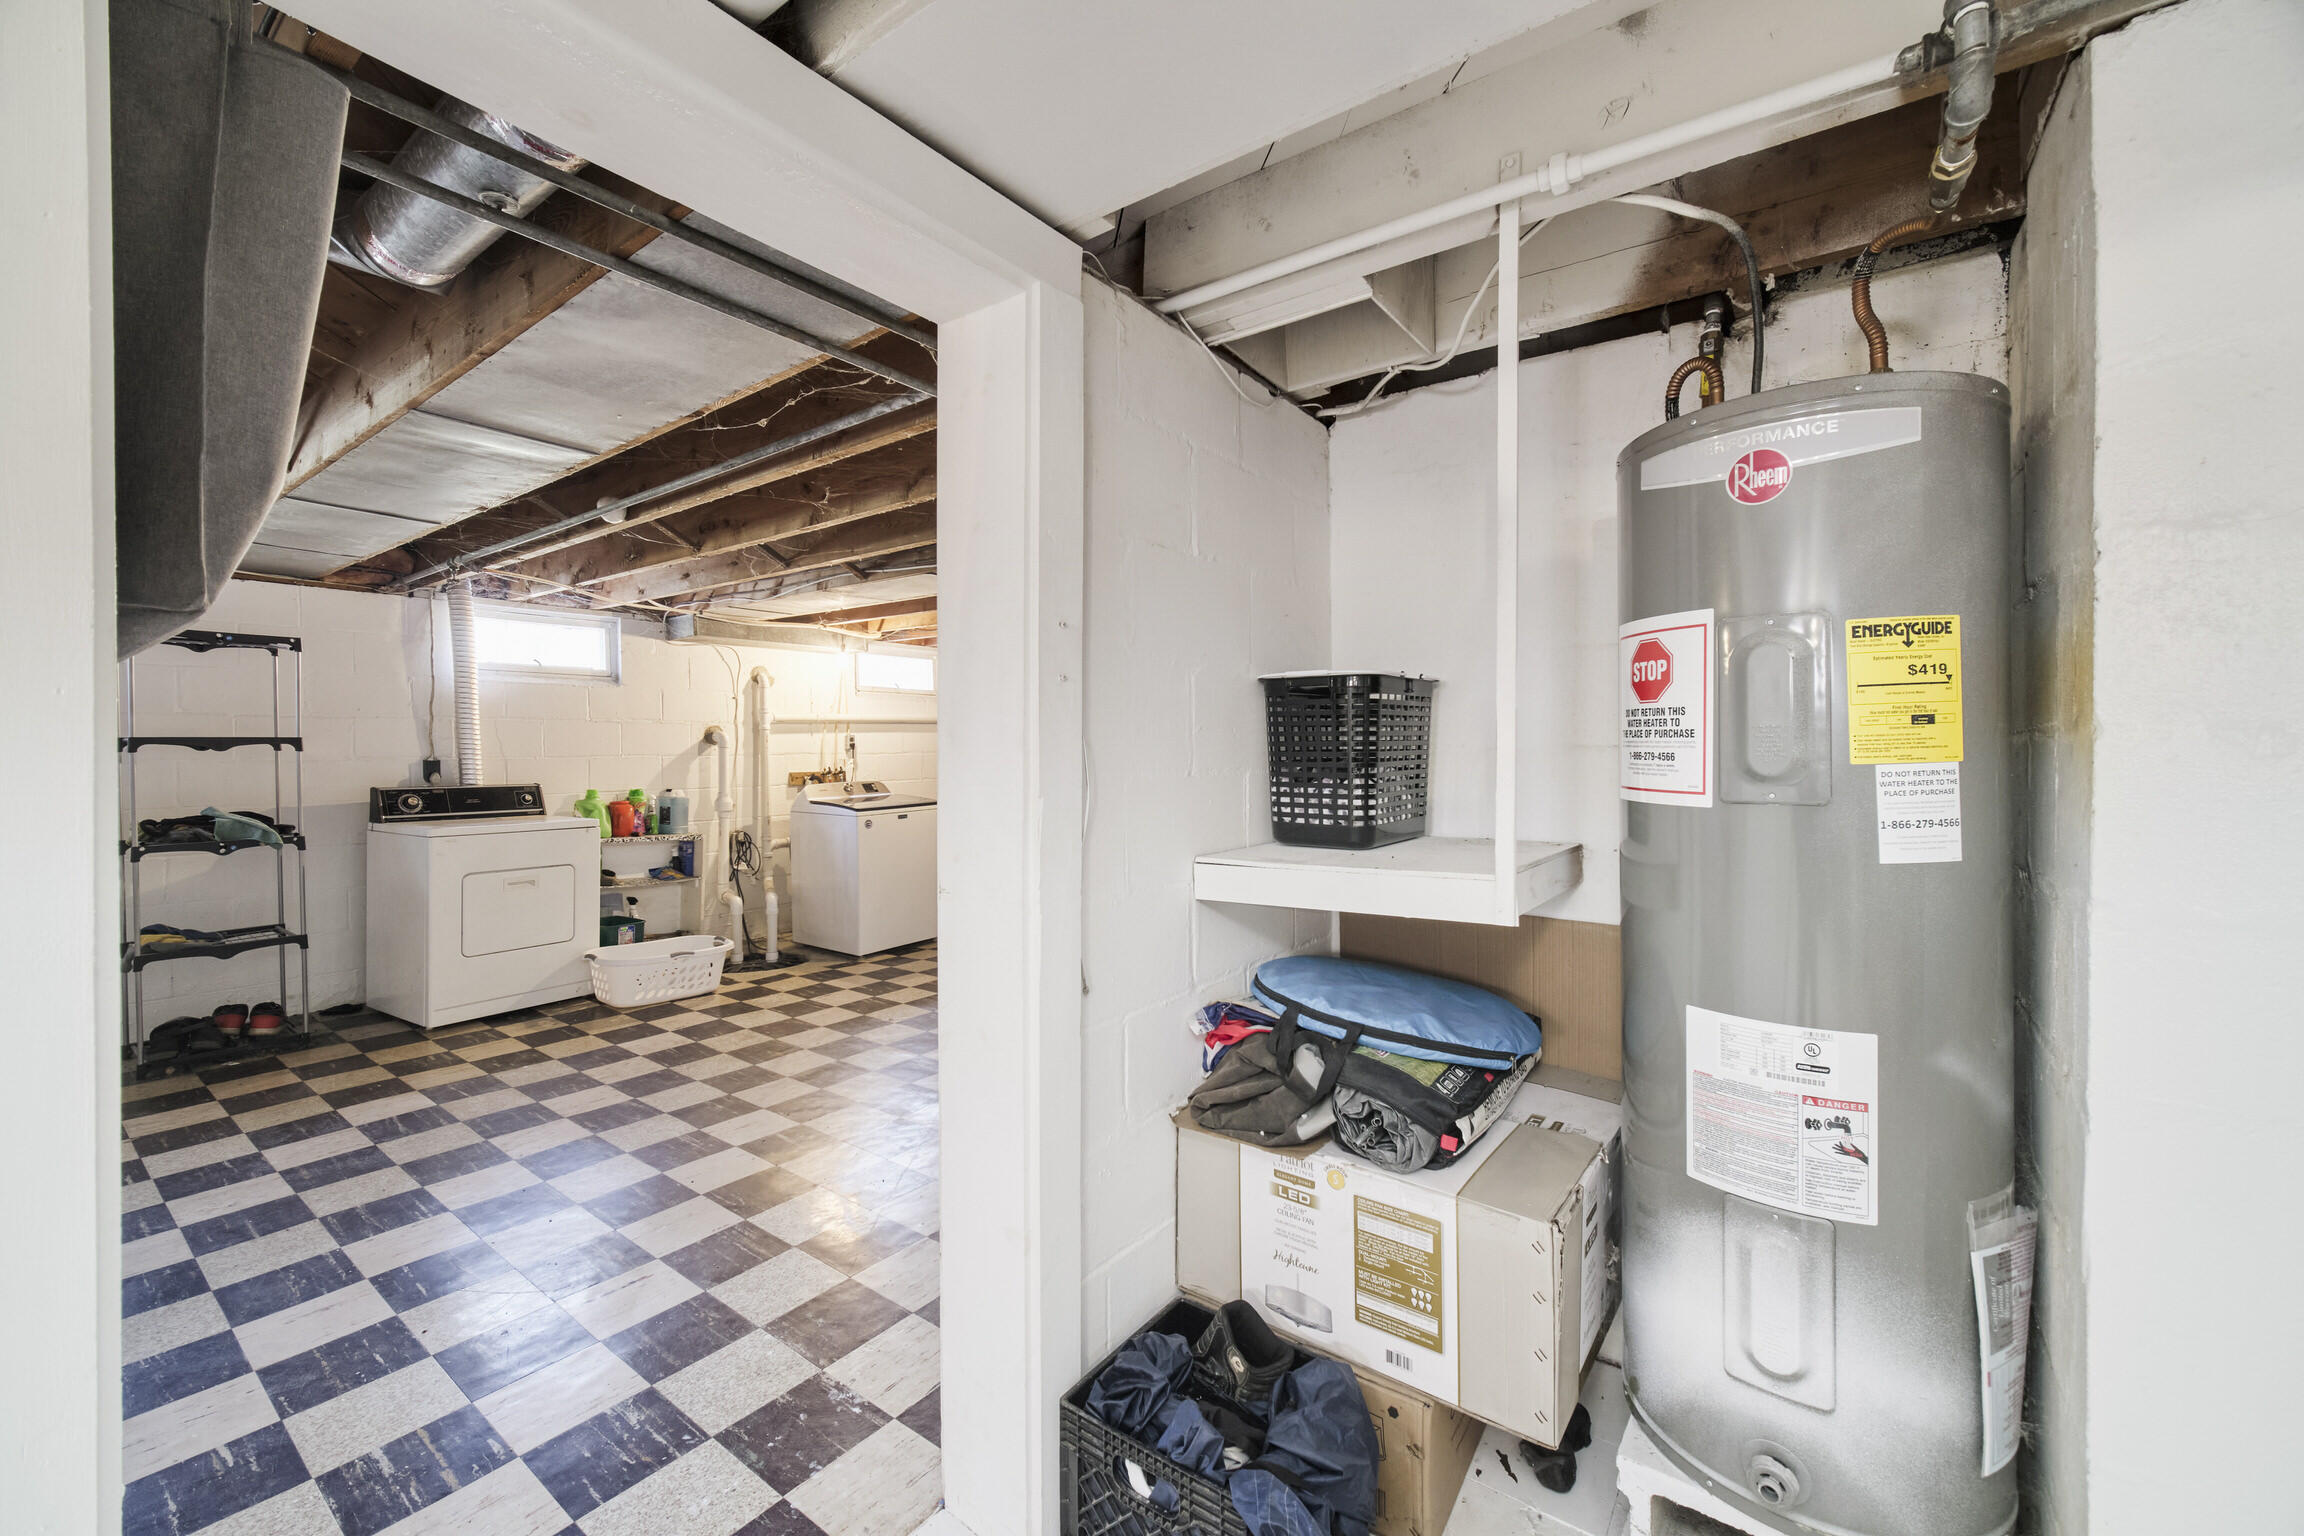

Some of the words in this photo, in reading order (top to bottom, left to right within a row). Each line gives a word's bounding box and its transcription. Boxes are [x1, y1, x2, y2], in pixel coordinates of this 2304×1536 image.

[1698, 419, 1840, 456] ERFORMANCE
[1734, 451, 1788, 498] Rheem
[1851, 621, 1953, 639] ENERGYGUIDE
[1633, 659, 1668, 683] STOP
[1908, 663, 1948, 676] $419
[1641, 707, 1666, 717] RETURN
[1668, 706, 1686, 716] THIS
[1643, 718, 1668, 728] HEATER
[1670, 718, 1681, 727] TO
[1629, 729, 1643, 738] PLACE
[1644, 729, 1652, 738] OF
[1654, 729, 1695, 738] PURCHASE
[1912, 769, 1941, 777] RETURN
[1907, 779, 1935, 787] HEATER
[1884, 789, 1907, 797] PLACE
[1920, 788, 1955, 796] PURCHASE
[1880, 818, 1960, 830] 1-866-279-4566
[1817, 1099, 1866, 1112] DANGER
[1278, 1185, 1311, 1205] LED
